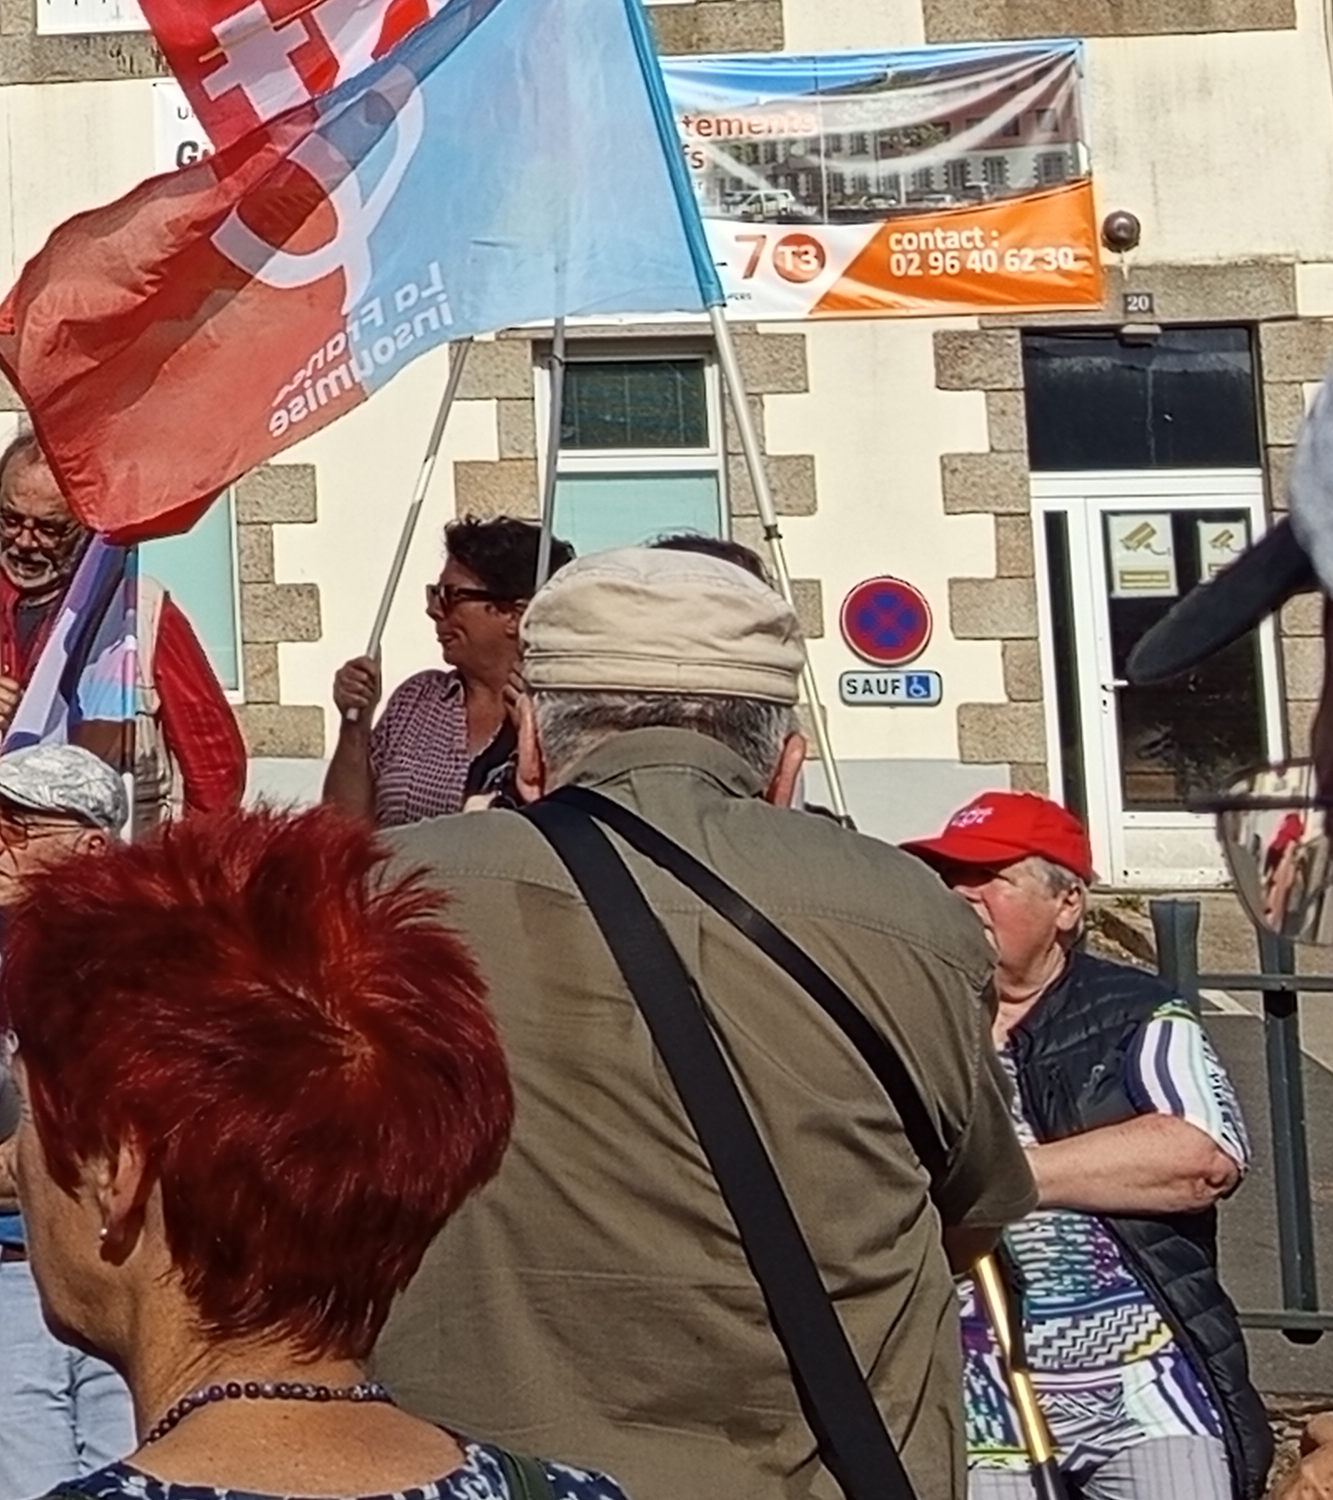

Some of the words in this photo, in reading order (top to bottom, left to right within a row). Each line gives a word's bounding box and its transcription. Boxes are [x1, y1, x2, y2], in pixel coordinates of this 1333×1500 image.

[681, 113, 815, 138] tements
[889, 226, 985, 252] contact
[777, 244, 819, 273] T3
[890, 252, 923, 277] 02
[928, 251, 961, 276] 96
[966, 249, 999, 274] 40
[1004, 248, 1037, 273] 62
[1041, 246, 1075, 272] 30
[1126, 295, 1151, 311] 20
[845, 678, 902, 696] SAUF
